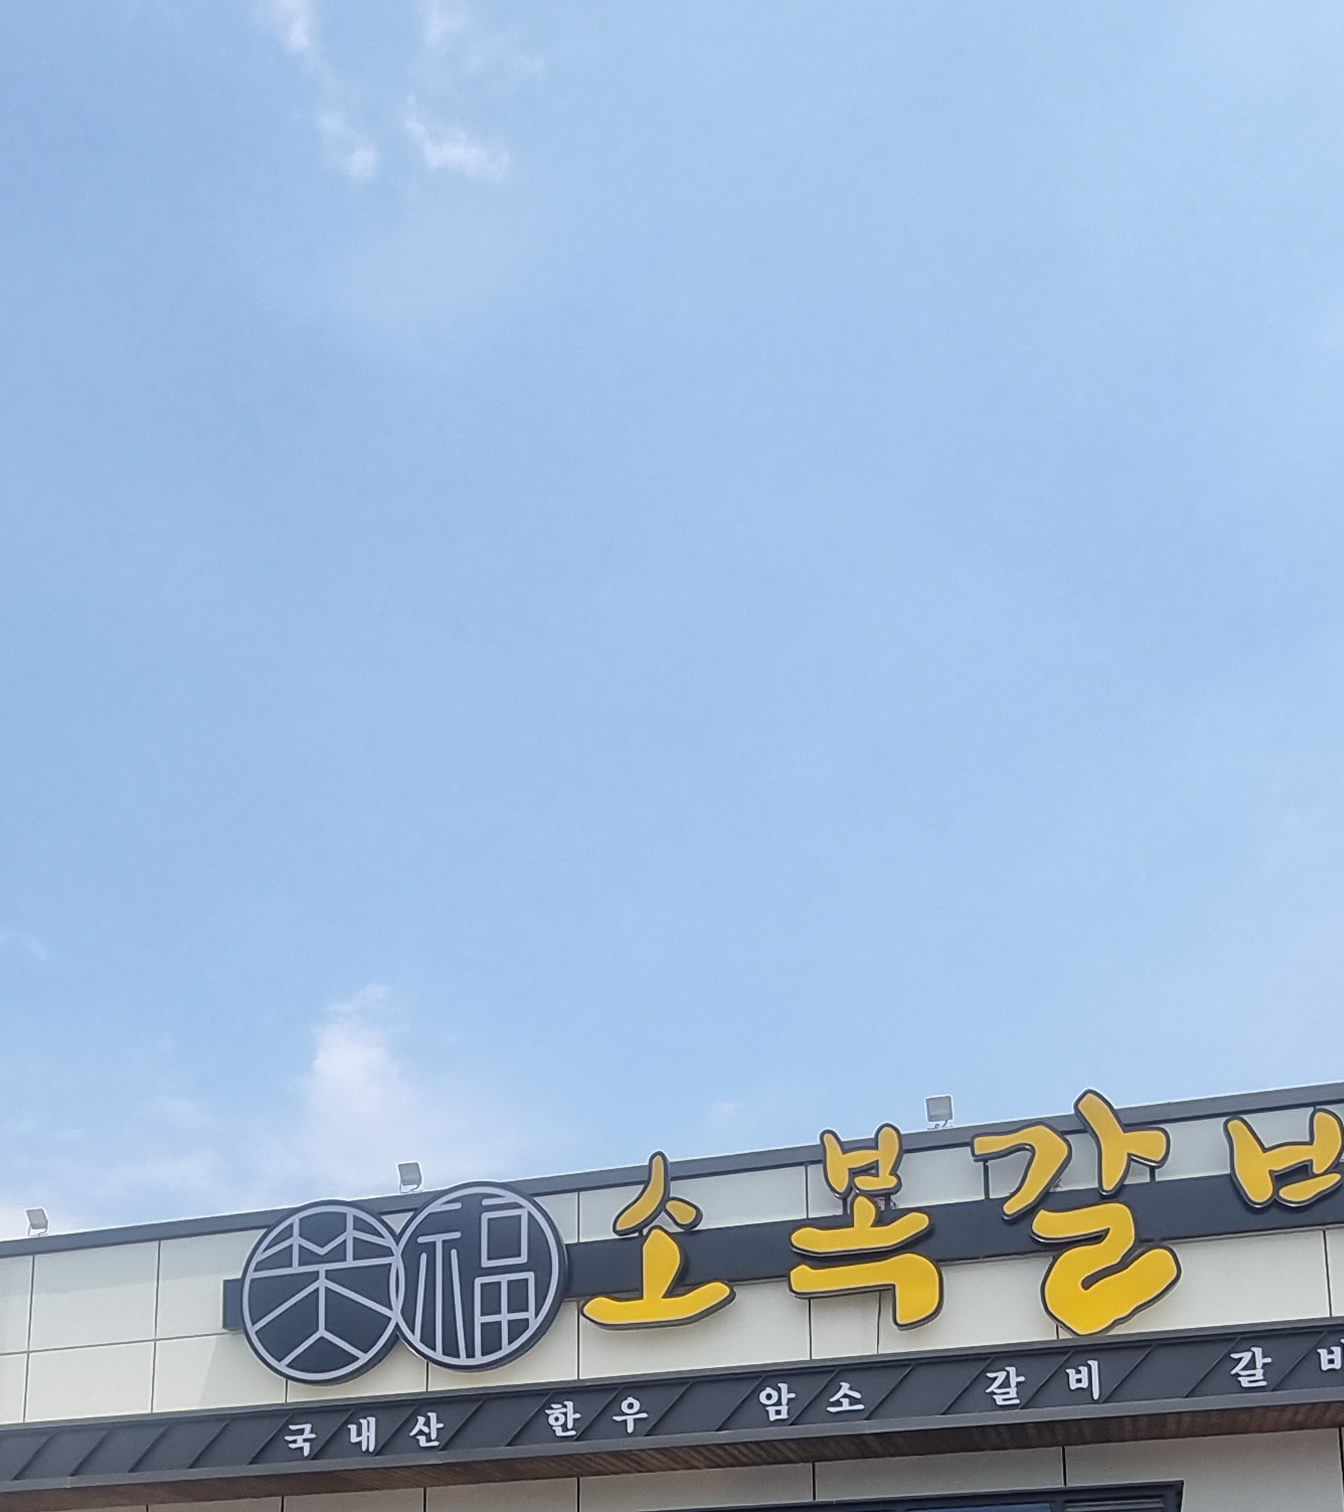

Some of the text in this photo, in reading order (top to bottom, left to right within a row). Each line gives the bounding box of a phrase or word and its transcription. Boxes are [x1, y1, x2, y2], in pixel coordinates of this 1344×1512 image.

[284, 1413, 445, 1457] 국내산
[544, 1396, 649, 1437] 한우
[759, 1381, 866, 1422] 암소
[985, 1357, 1102, 1407] 갈비
